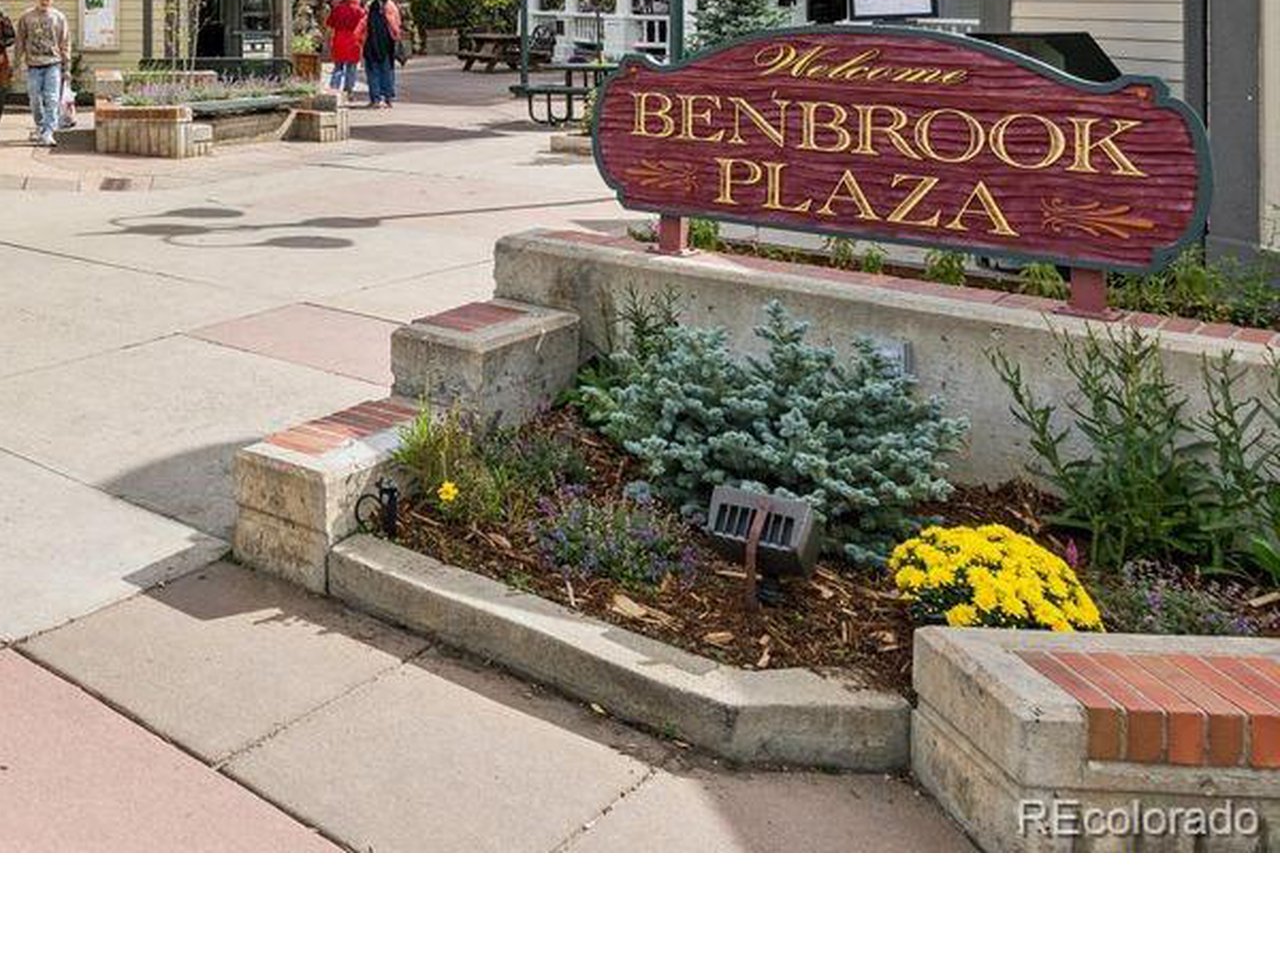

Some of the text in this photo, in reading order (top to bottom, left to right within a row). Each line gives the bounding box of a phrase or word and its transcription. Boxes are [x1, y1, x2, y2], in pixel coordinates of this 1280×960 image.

[754, 43, 969, 86] Welcome
[631, 90, 1149, 178] BENBROOK
[713, 157, 1021, 238] PLAZA
